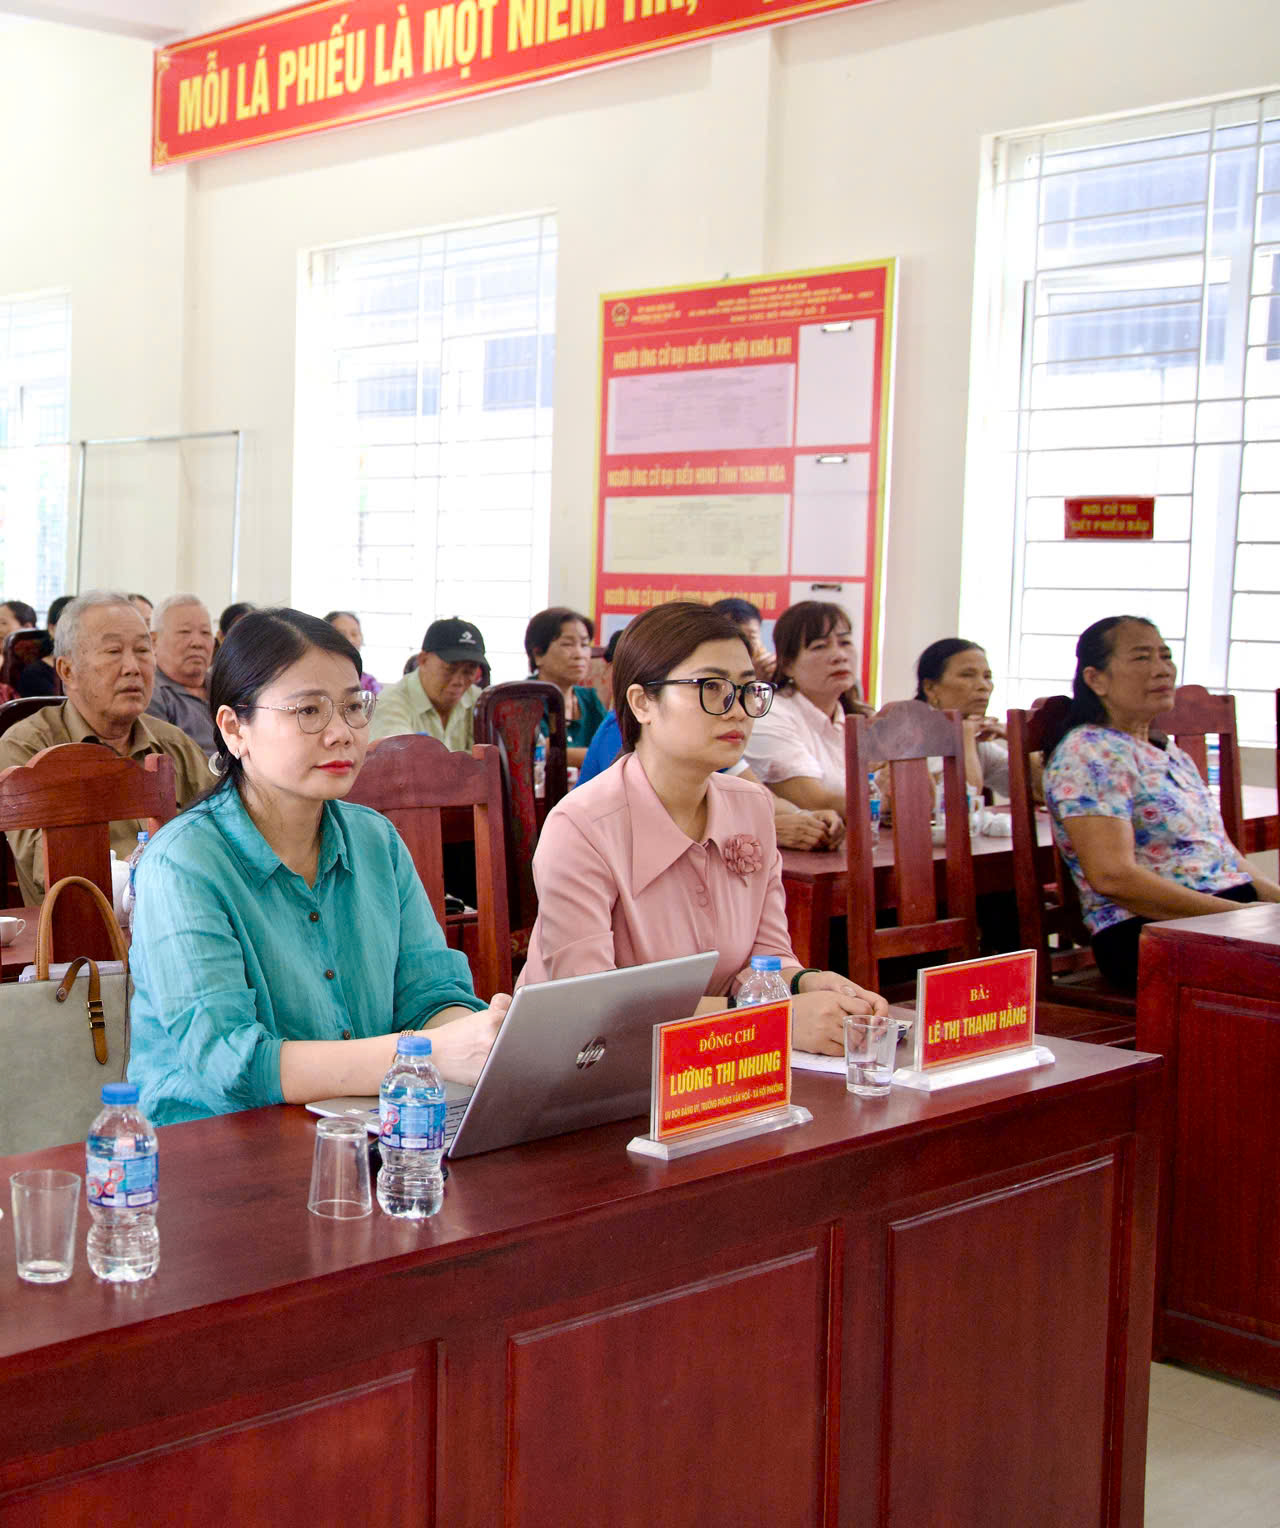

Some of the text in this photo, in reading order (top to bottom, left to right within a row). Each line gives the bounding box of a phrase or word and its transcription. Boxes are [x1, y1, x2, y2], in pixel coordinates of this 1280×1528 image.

[178, 50, 229, 134] MỖI
[236, 44, 270, 120] LÁ
[277, 13, 367, 110] PHIẾU
[374, 4, 412, 86] LÀ
[613, 347, 638, 369] NGƯỜI
[639, 344, 657, 368] ỨNG
[708, 336, 731, 364] QUỐC
[608, 467, 630, 487] NGƯỜI
[631, 467, 648, 487] ỨNG
[739, 465, 767, 484] THANH
[970, 984, 989, 1001] BÀ:
[699, 1024, 756, 1053] ĐỒNG CHÍ
[928, 1002, 1027, 1044] LÊ THỊ THANH HẰNG
[670, 1050, 781, 1096] LƯỜNG THỊ NHUNG
